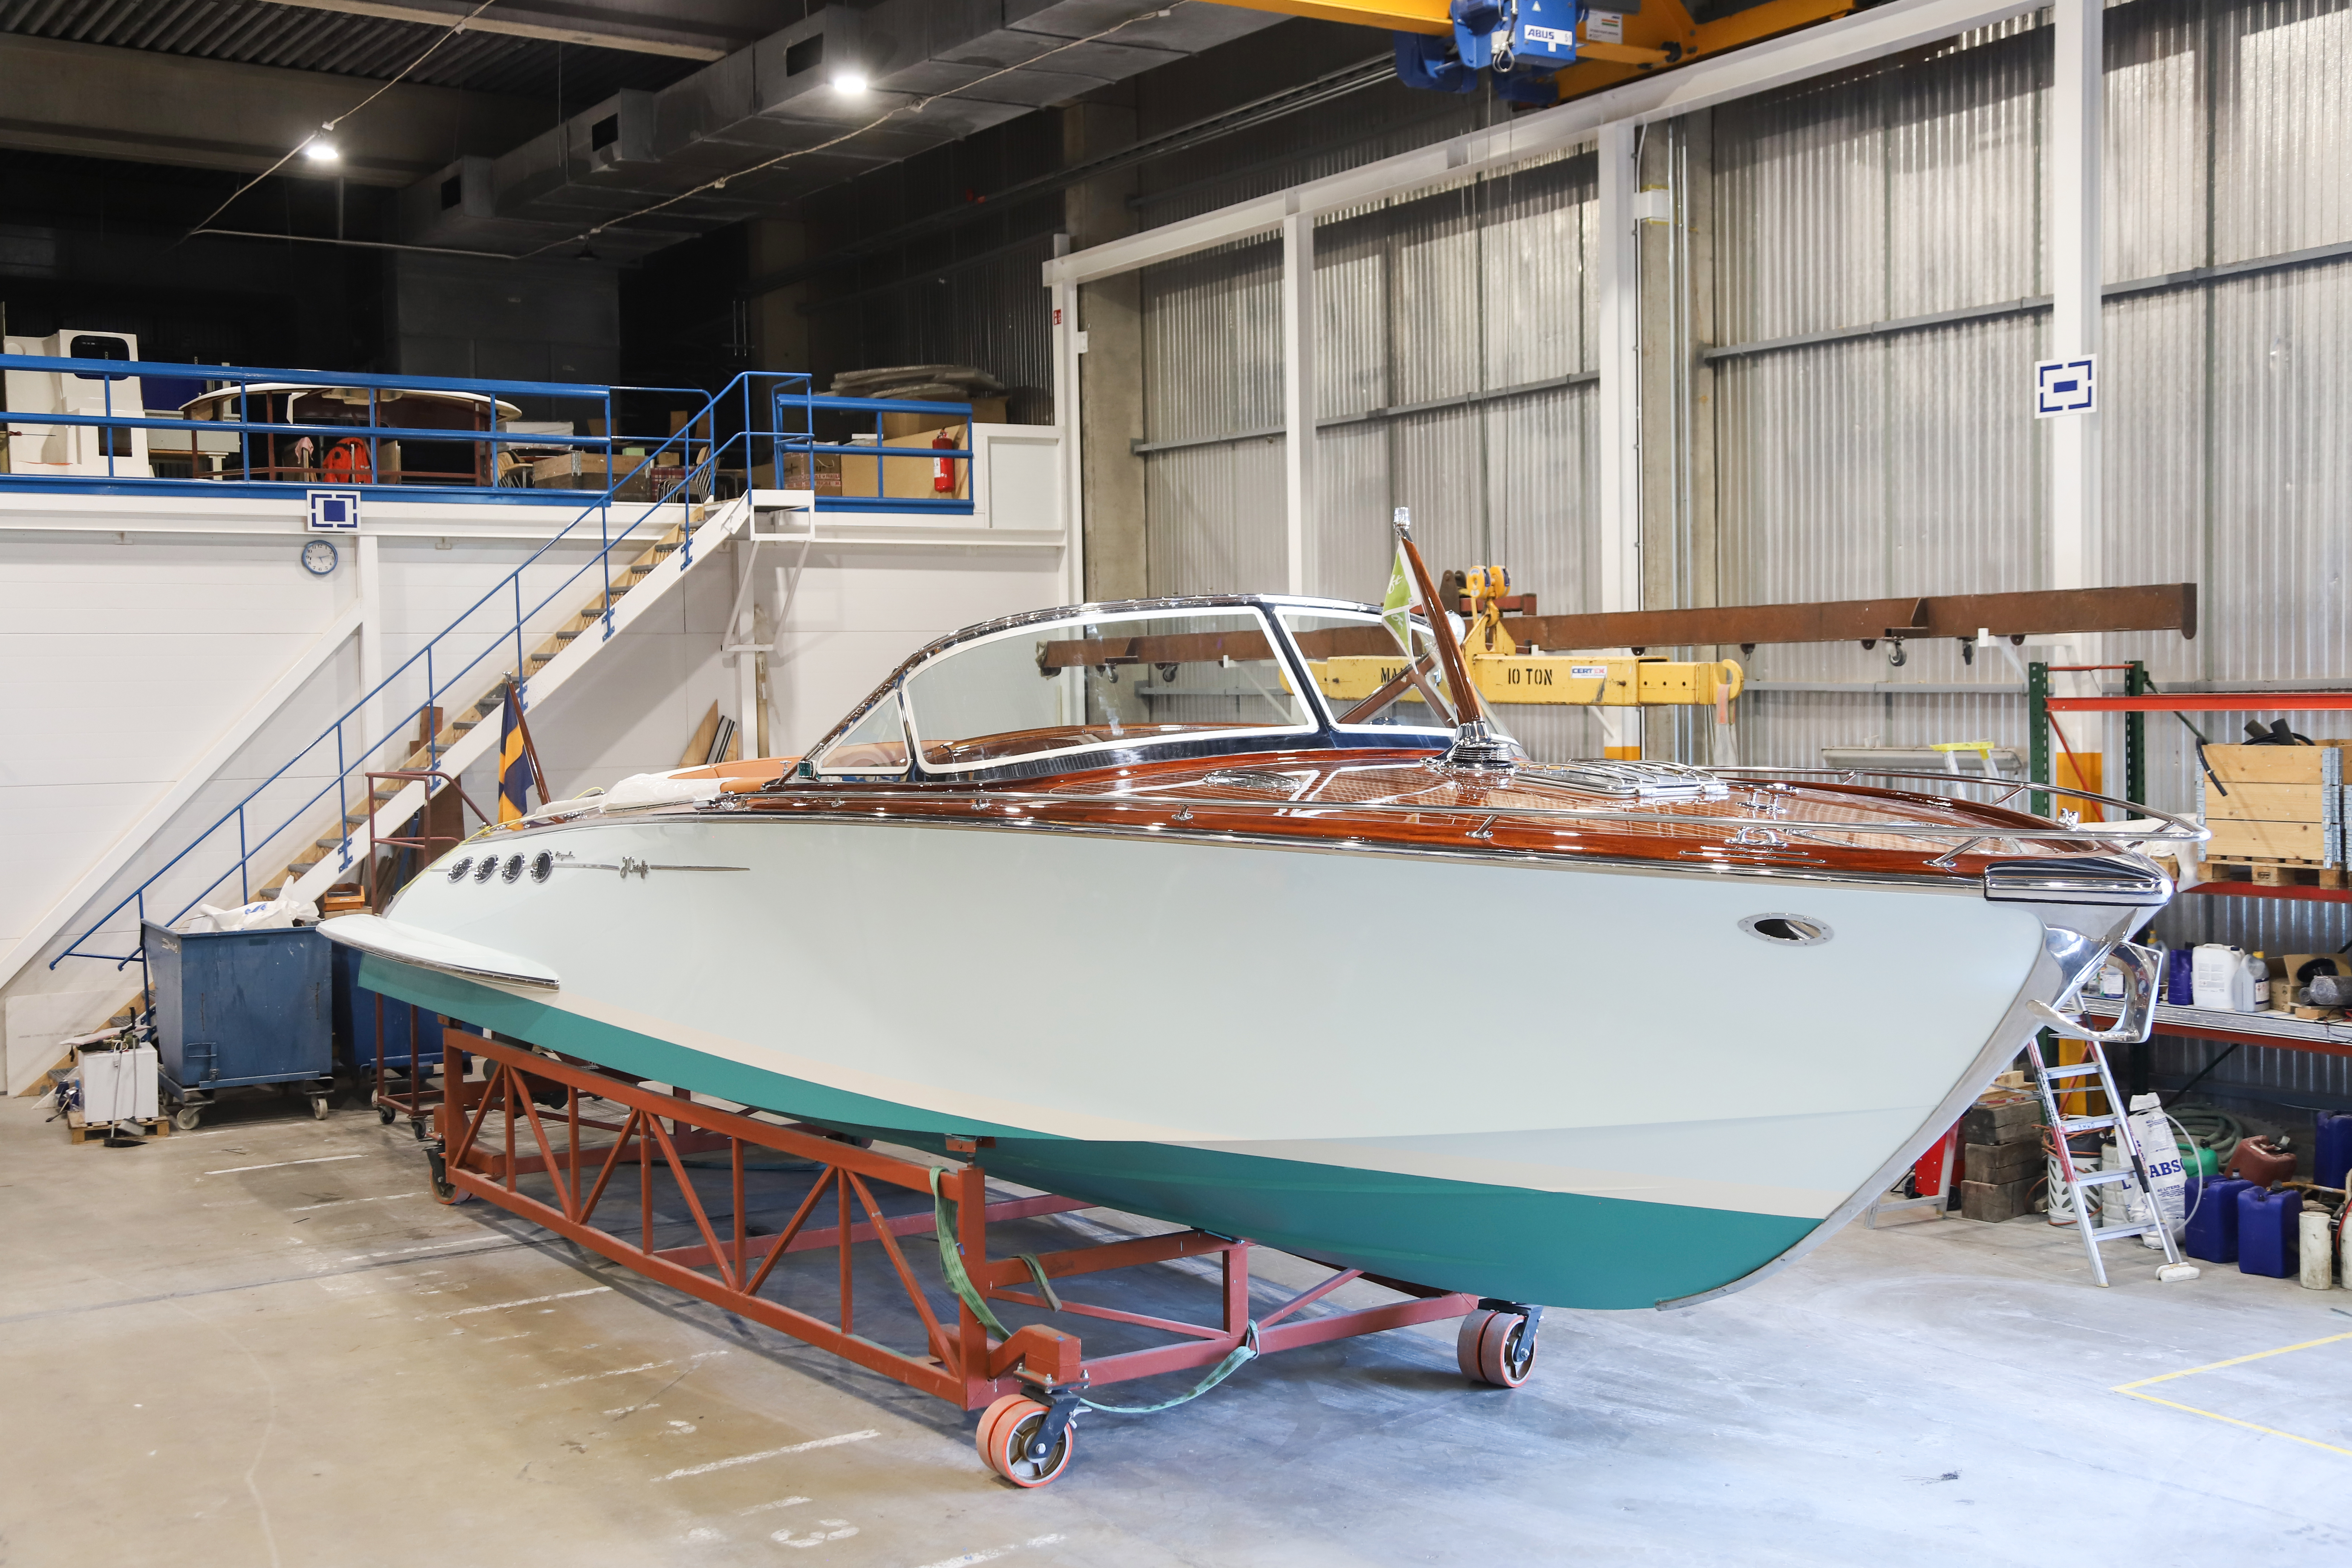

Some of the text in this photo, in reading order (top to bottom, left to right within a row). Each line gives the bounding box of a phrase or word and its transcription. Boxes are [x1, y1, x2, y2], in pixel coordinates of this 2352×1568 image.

[1528, 29, 1554, 39] ABUS
[1381, 667, 1552, 685] MA 10 TON
